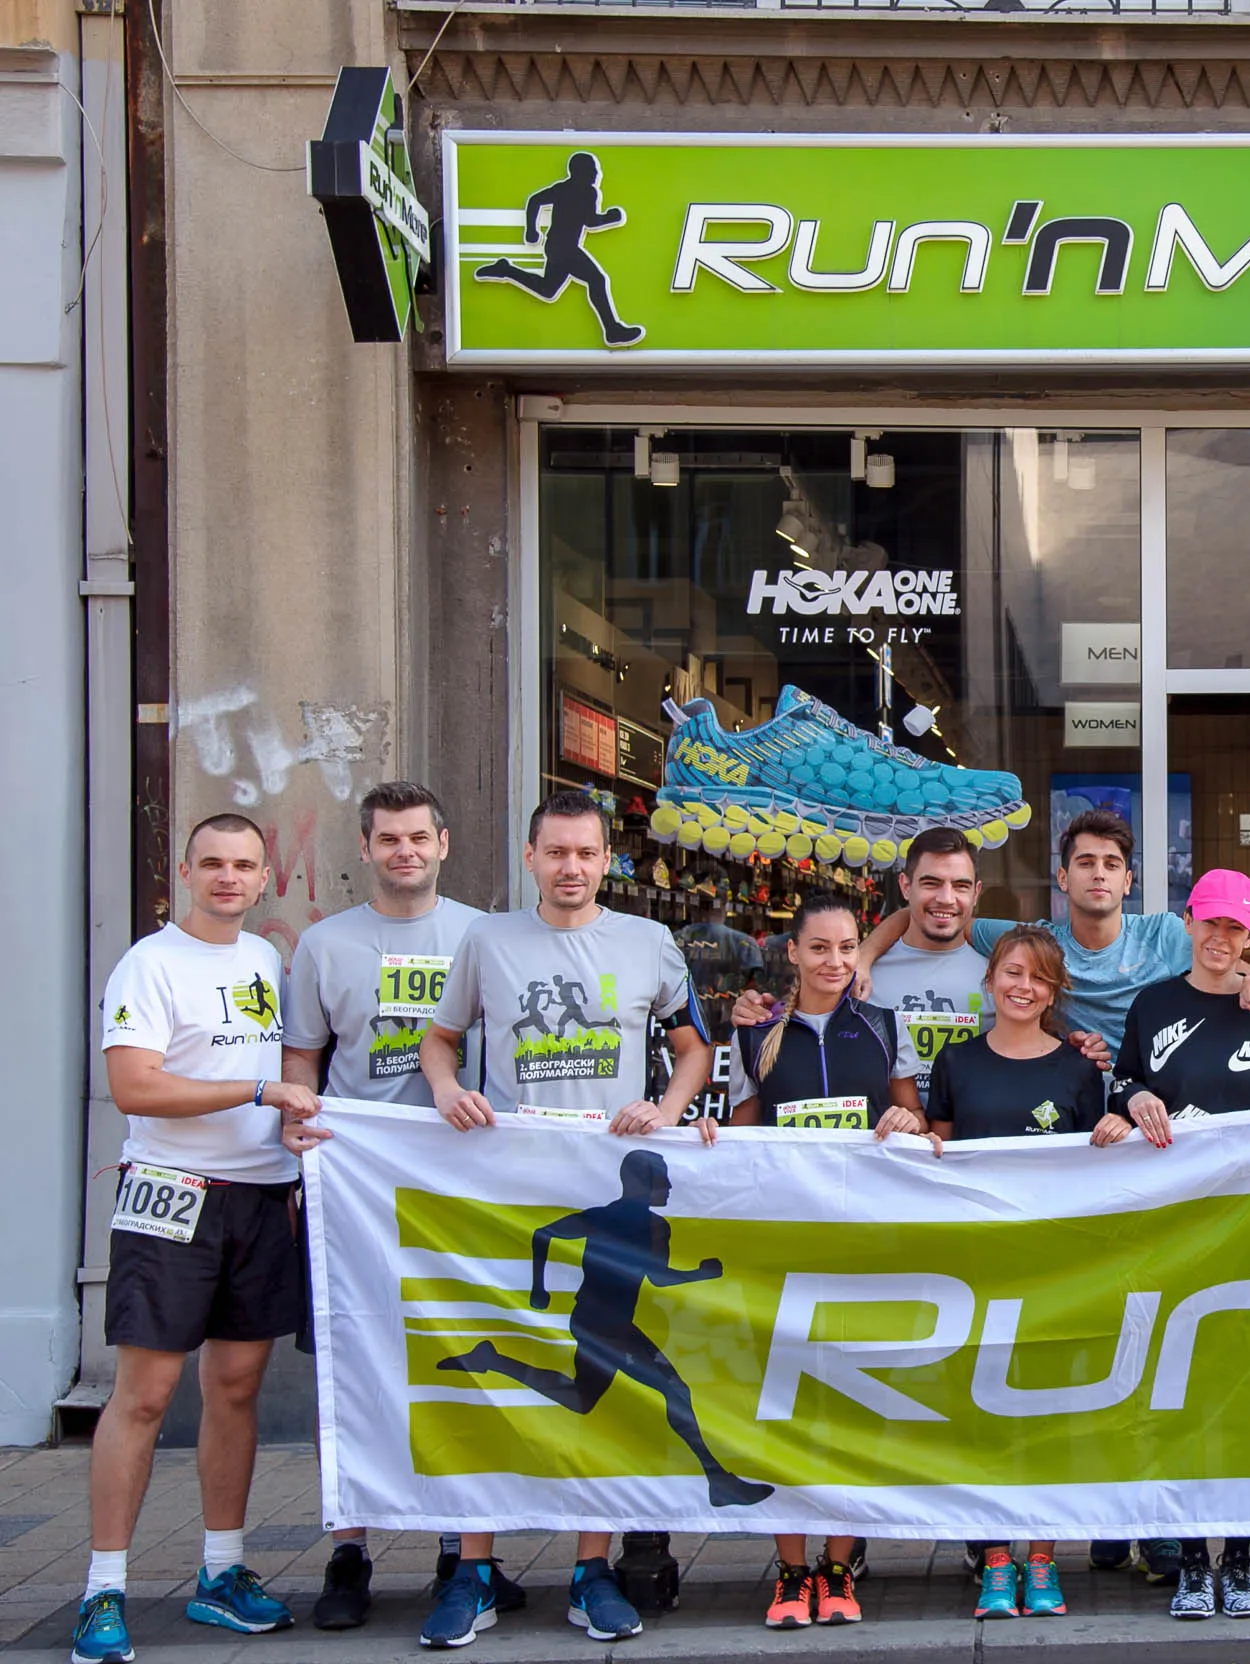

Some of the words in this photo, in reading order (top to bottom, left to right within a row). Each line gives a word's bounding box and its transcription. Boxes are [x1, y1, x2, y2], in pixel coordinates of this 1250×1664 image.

[401, 197, 428, 244] More
[746, 569, 898, 615] HOKA
[893, 570, 954, 593] ONE
[779, 627, 835, 644] TIME
[847, 627, 876, 644] TO
[1087, 647, 1138, 660] MEN
[1071, 719, 1137, 730] WOMEN
[674, 737, 750, 787] HOKA
[387, 969, 447, 1002] 196
[216, 986, 232, 1024] I
[259, 1031, 283, 1043] Mo
[1153, 1017, 1188, 1057] NIKE
[376, 1058, 385, 1066] 2.
[386, 1052, 420, 1065] БЕОГРА
[519, 1063, 528, 1072] 2.
[529, 1058, 595, 1071] БЕОГРАДСКИ
[376, 1061, 420, 1075] ПОЛУМАР
[519, 1067, 595, 1081] ПОЛУМАРАТОН
[121, 1178, 197, 1225] 1082
